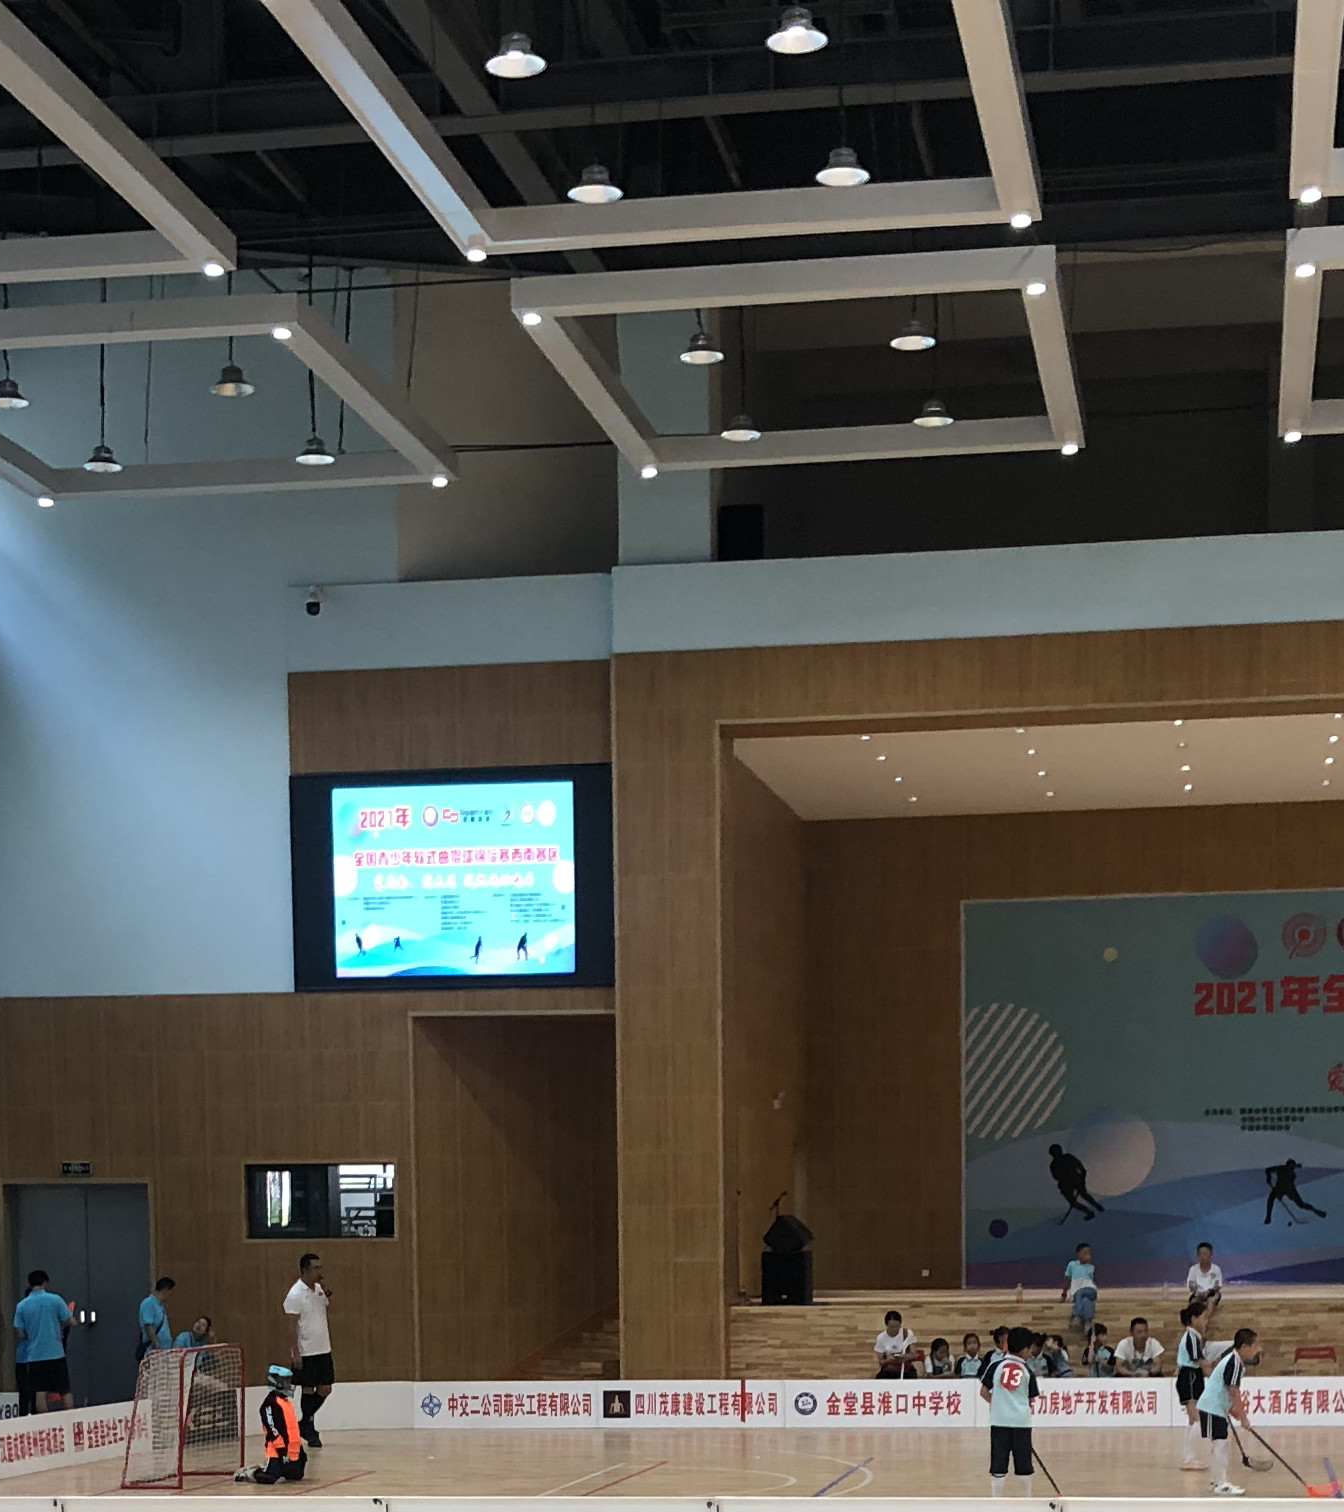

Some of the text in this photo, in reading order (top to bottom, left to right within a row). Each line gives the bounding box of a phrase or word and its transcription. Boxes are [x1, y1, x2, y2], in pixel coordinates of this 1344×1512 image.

[1000, 1367, 1022, 1387] 13
[827, 1390, 962, 1417] 金堂县淮口中学校
